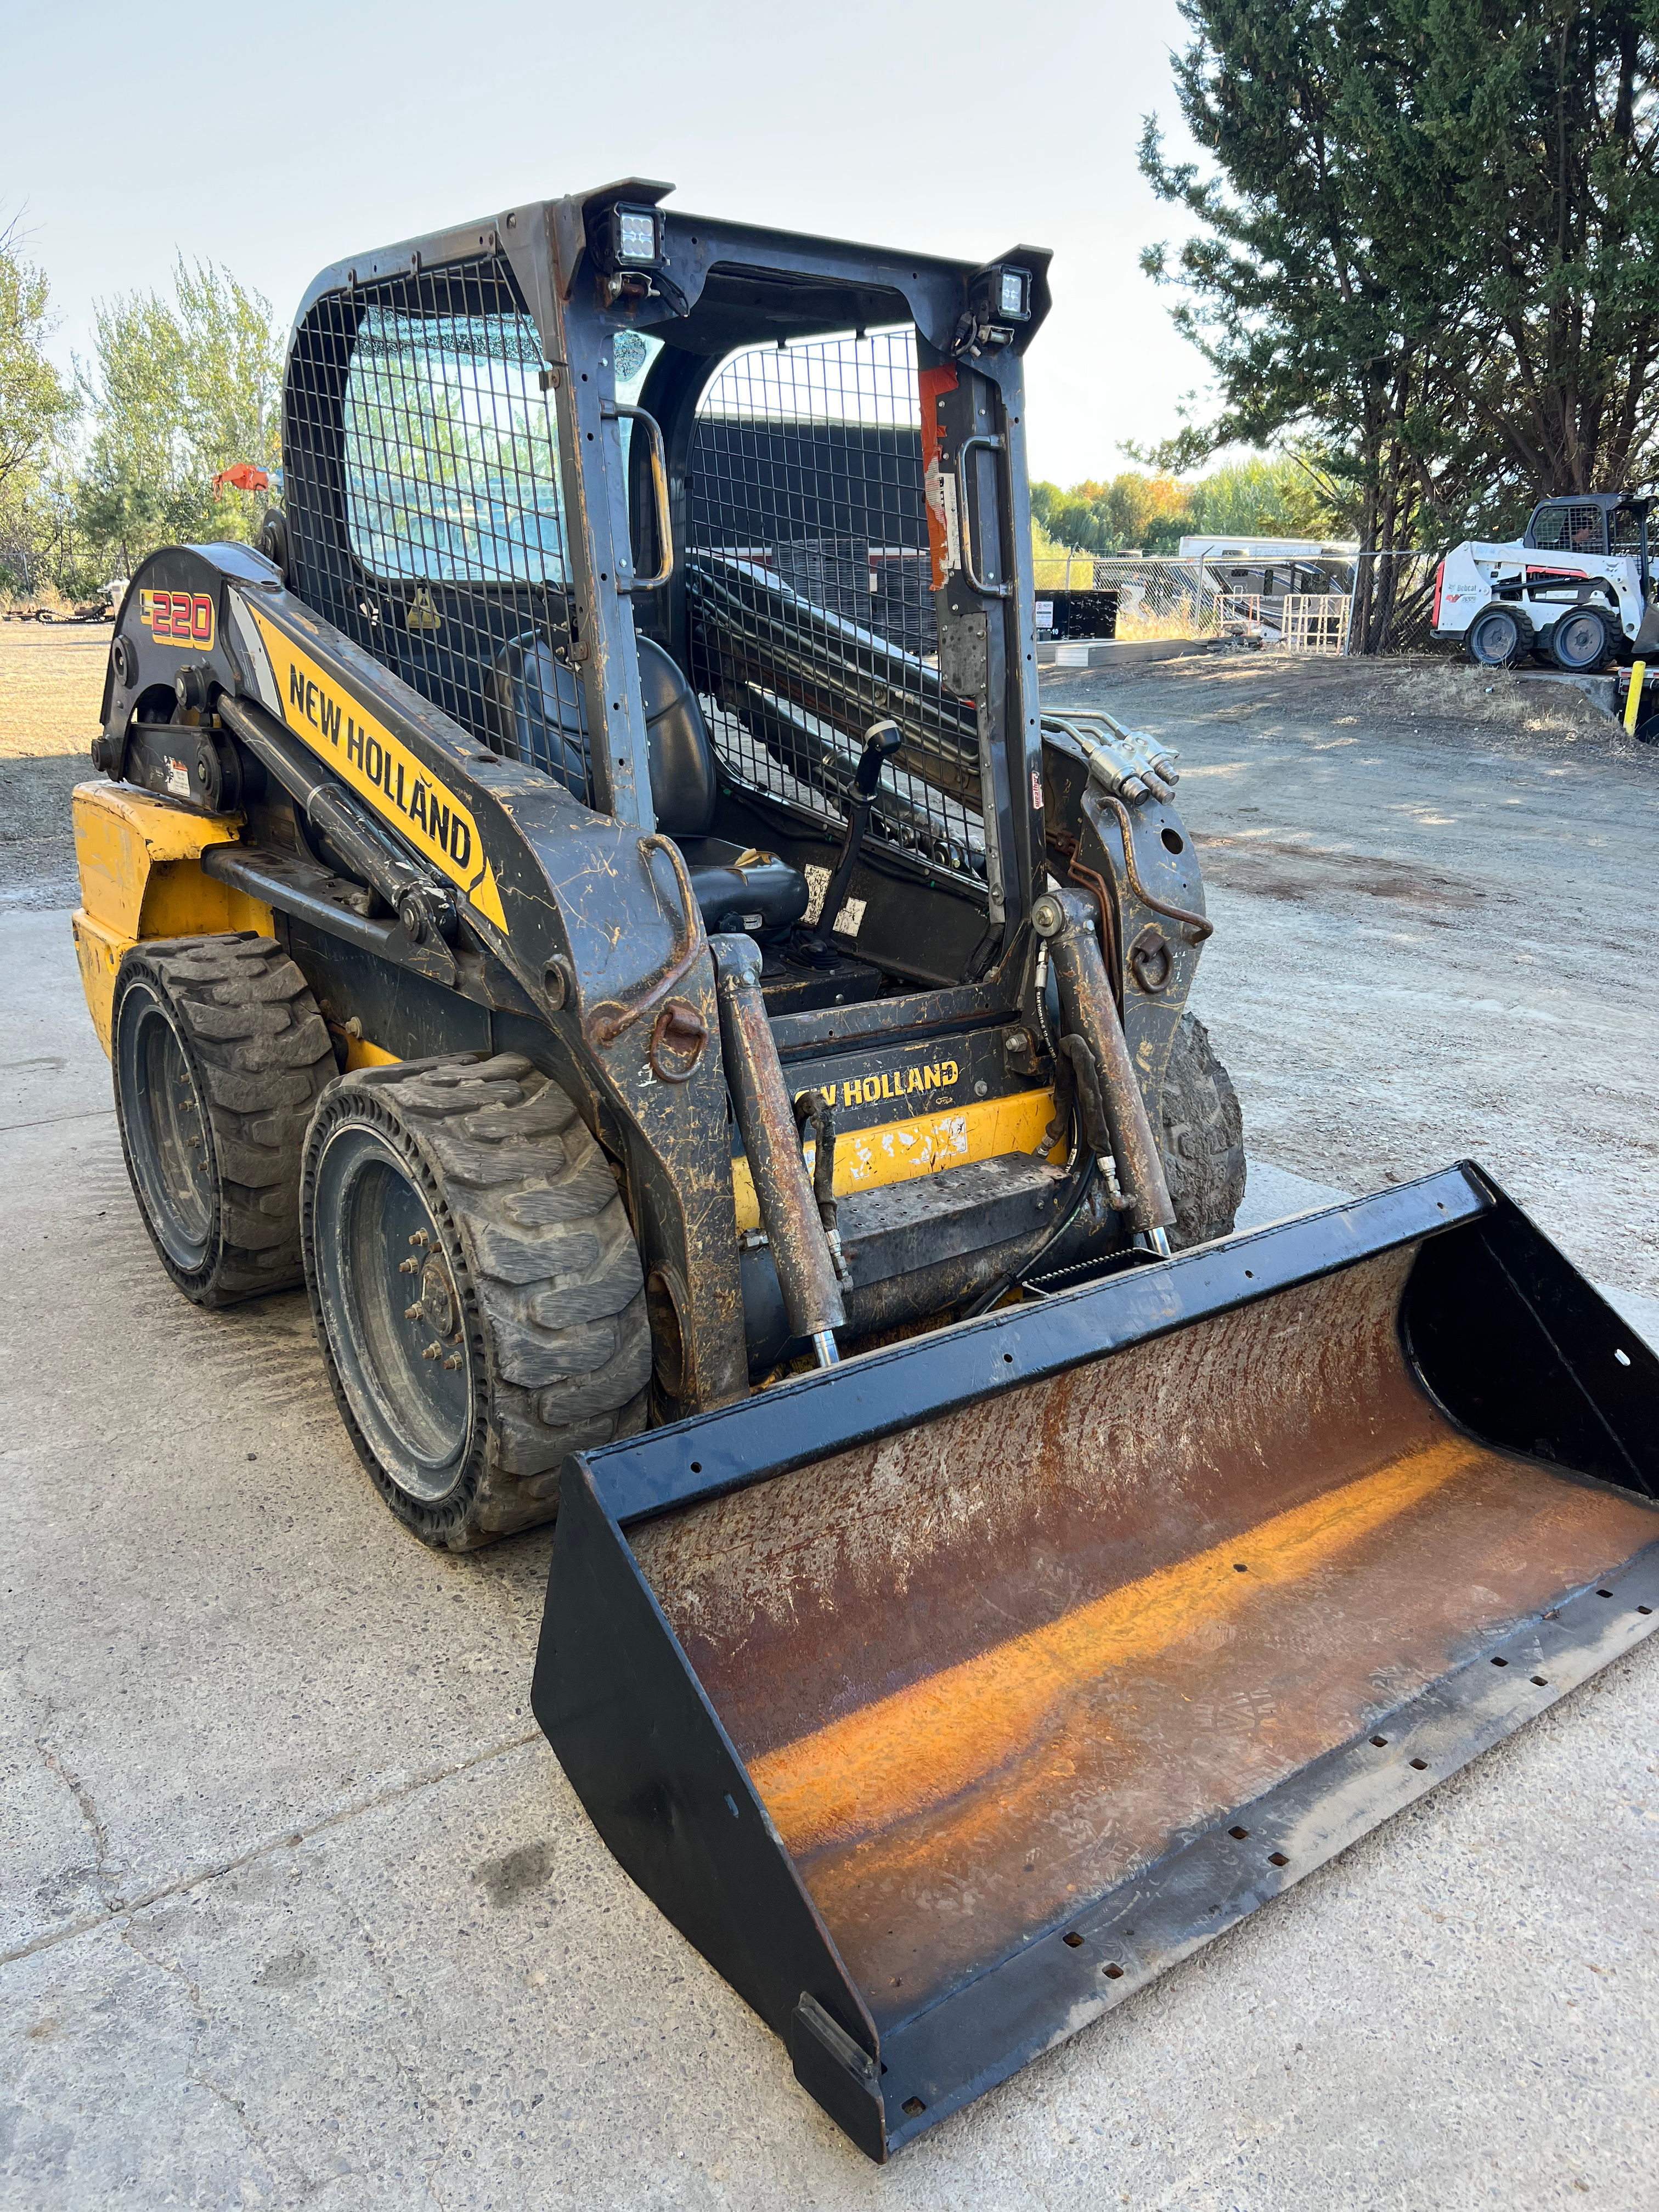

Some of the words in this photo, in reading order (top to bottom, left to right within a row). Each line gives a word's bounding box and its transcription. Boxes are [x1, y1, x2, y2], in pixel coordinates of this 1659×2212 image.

[290, 663, 342, 747] NEW
[347, 715, 471, 870] HOLLAND
[843, 1060, 958, 1107] HOLLAND
